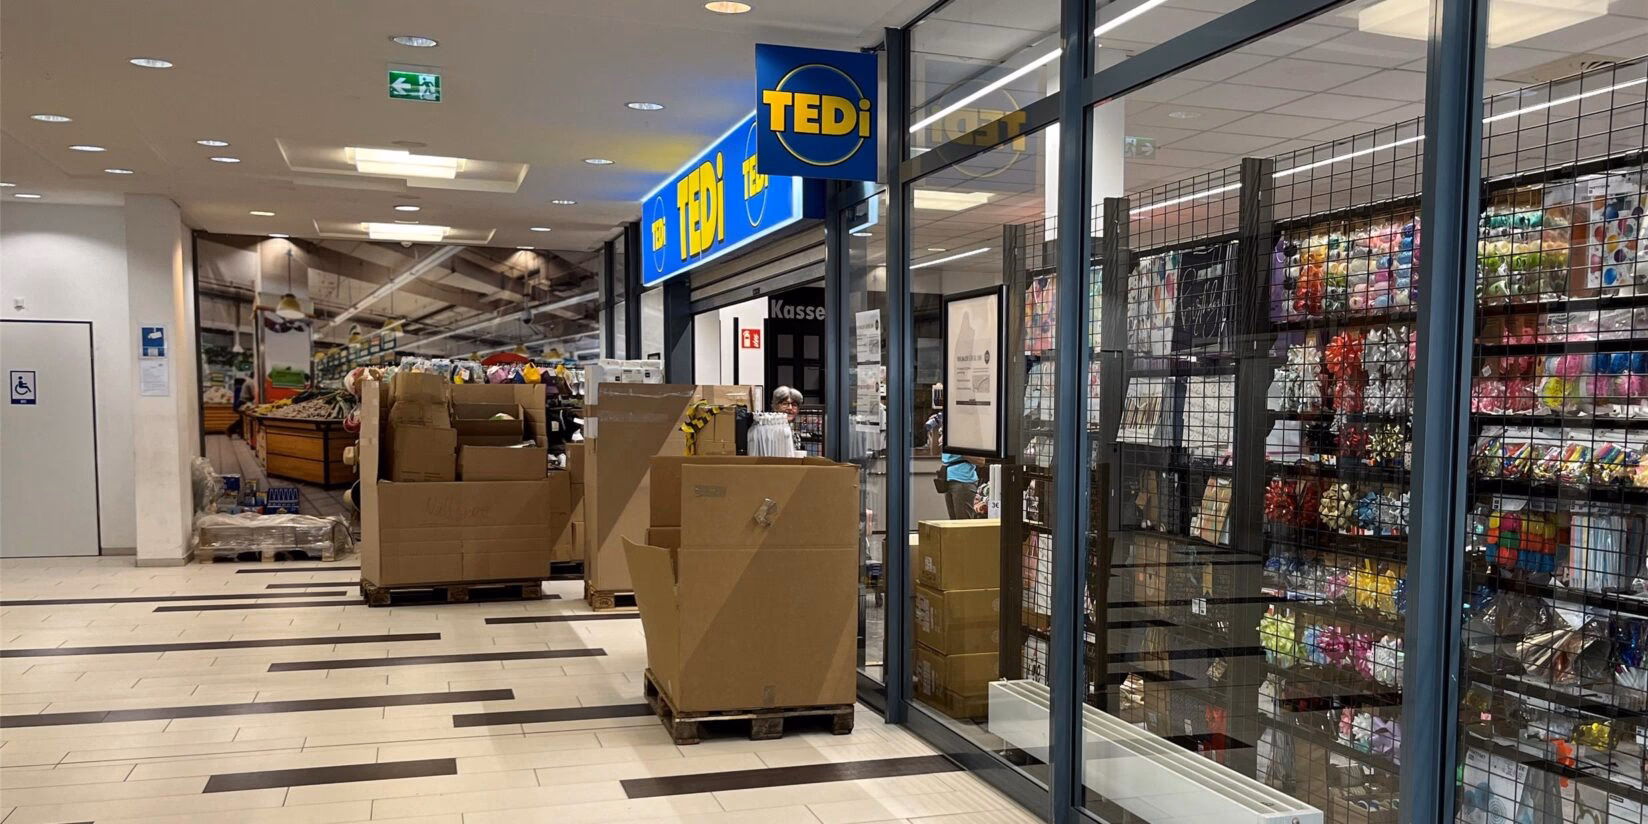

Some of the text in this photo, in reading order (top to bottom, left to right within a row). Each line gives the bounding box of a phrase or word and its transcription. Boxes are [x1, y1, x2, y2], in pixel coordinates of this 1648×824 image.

[762, 89, 872, 138] TEDi
[676, 151, 725, 262] TEDi
[771, 299, 826, 320] Kasse
